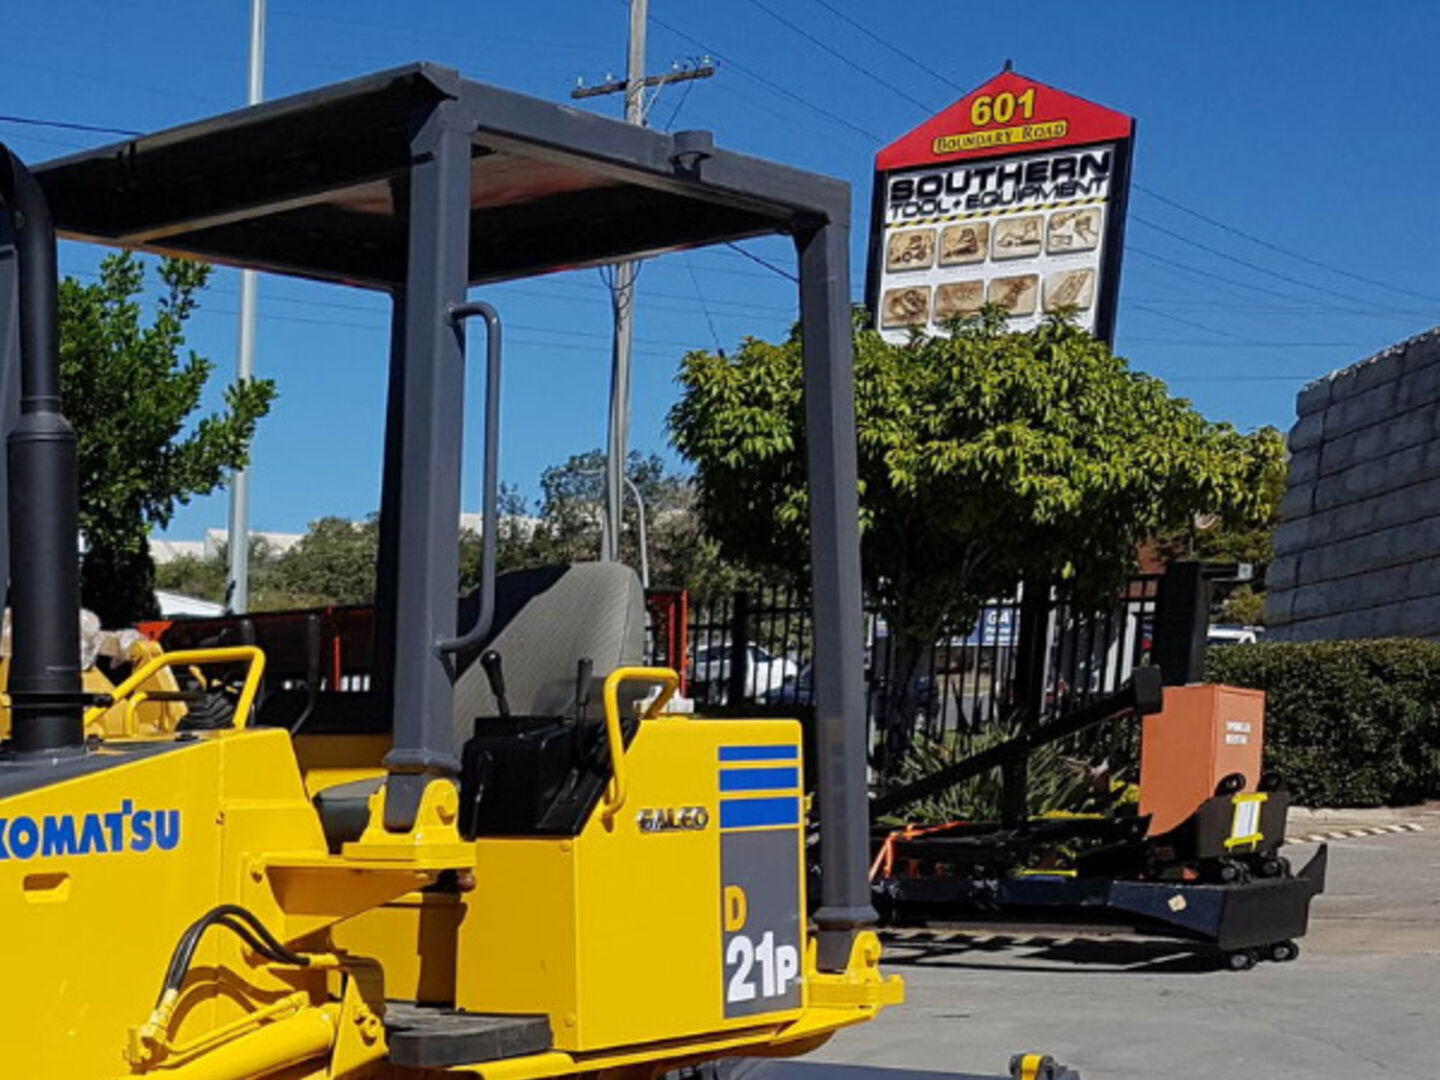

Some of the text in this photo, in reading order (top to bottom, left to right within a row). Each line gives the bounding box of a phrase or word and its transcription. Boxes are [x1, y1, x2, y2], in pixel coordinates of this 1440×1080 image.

[971, 88, 1036, 126] 601
[890, 151, 1111, 201] SOUTHERN
[890, 198, 950, 219] TOOL
[965, 176, 1109, 210] EQUIPMENT
[637, 806, 709, 833] GALEO
[724, 885, 747, 932] D
[726, 931, 799, 1003] 21P
